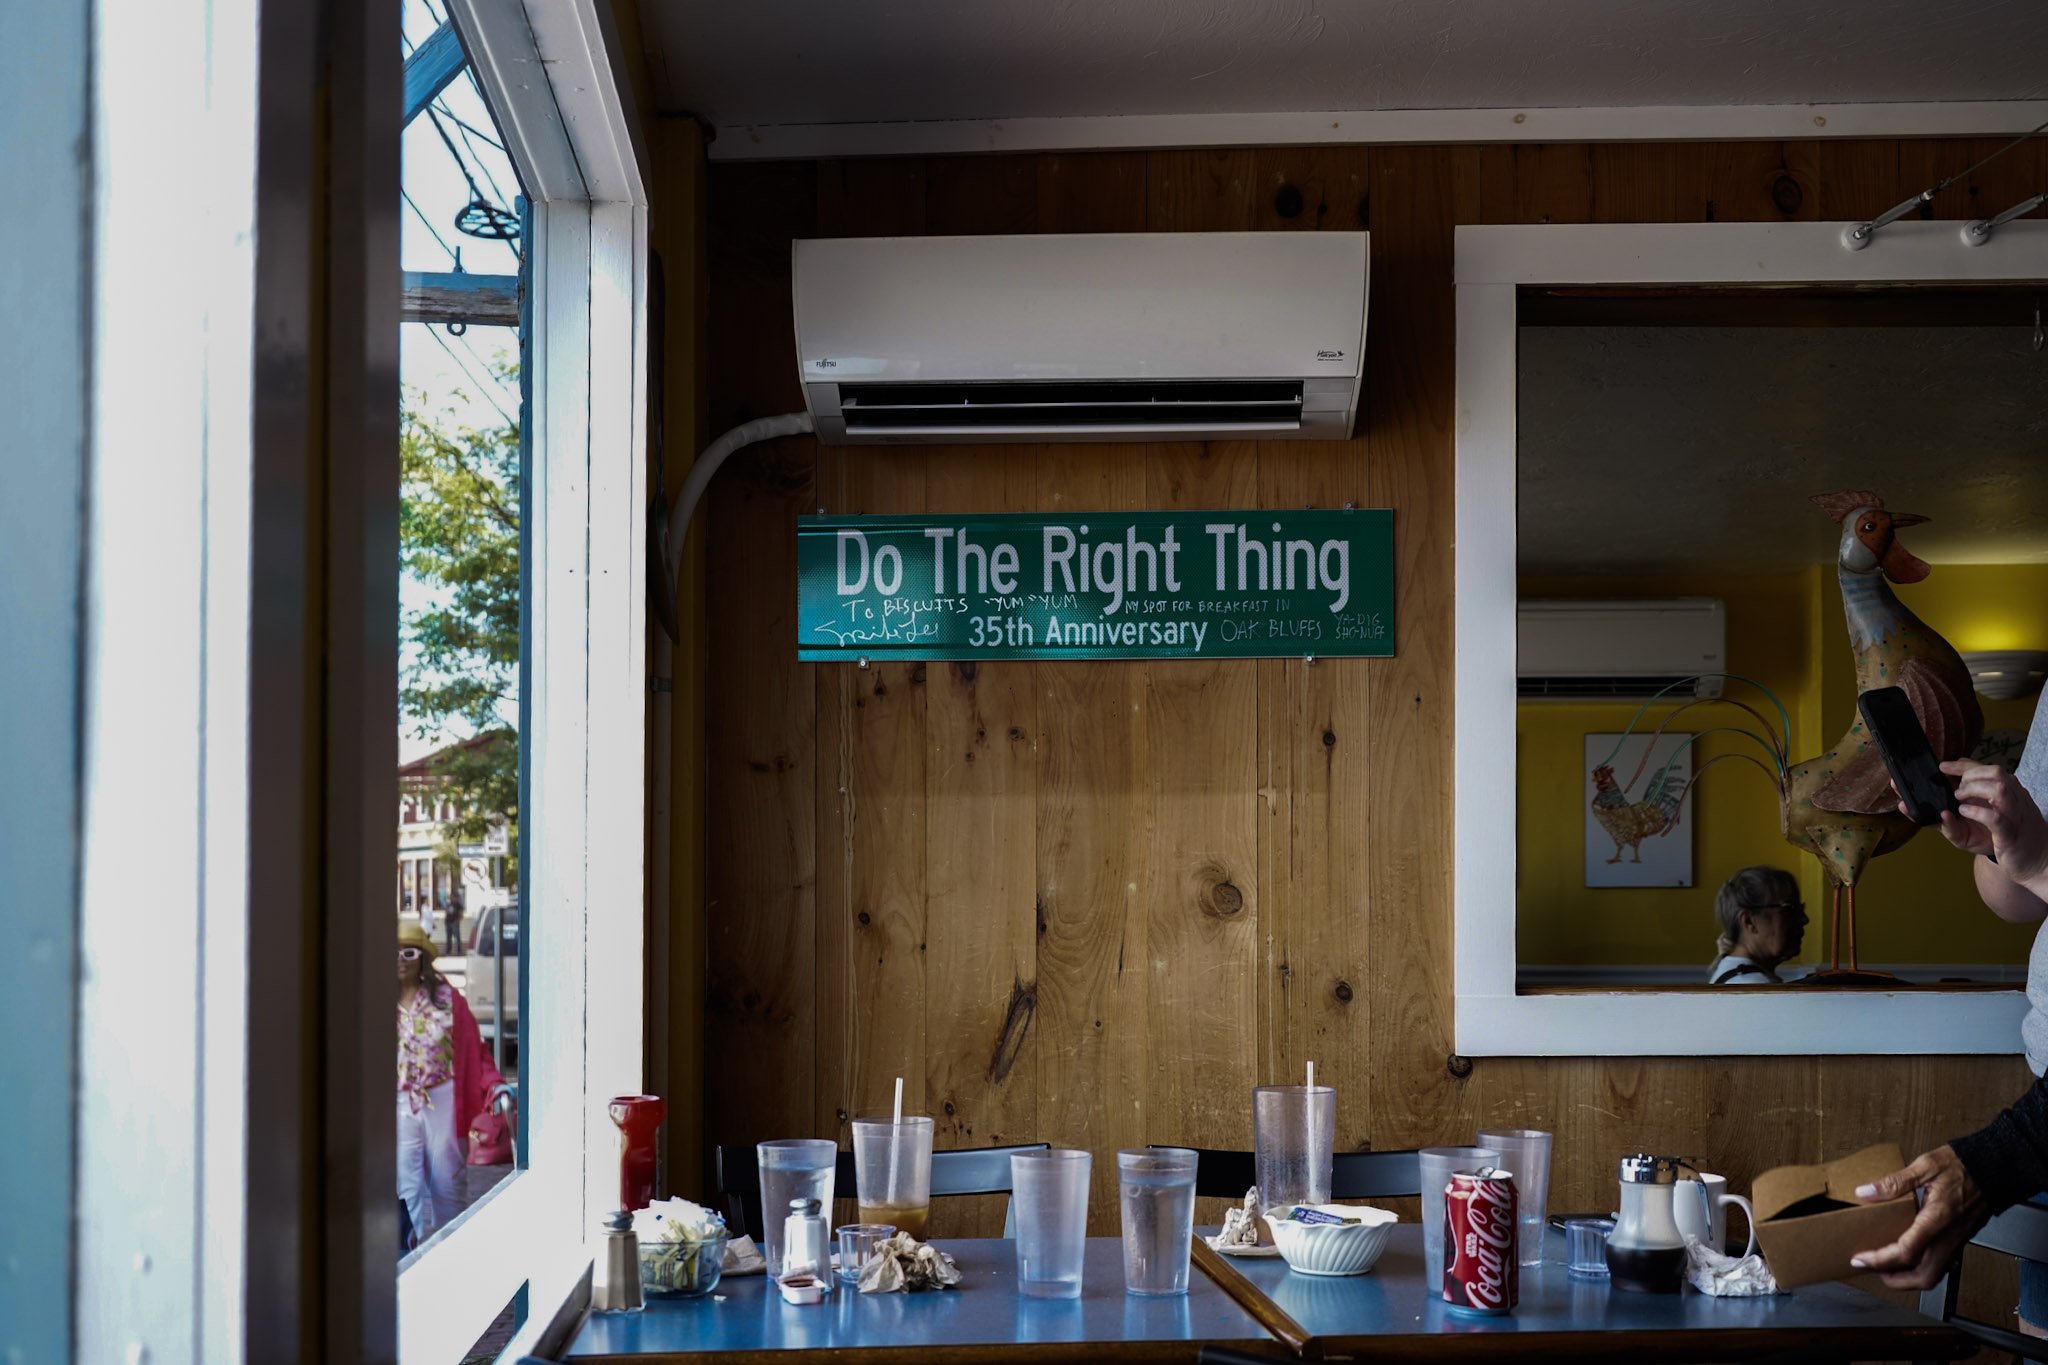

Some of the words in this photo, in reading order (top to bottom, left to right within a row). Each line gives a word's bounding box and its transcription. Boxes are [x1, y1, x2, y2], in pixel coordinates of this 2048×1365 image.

[837, 528, 903, 596] Do
[924, 527, 1020, 595] The
[1043, 525, 1181, 616] Right
[1205, 522, 1350, 614] Thing
[1125, 600, 1139, 614] MY
[1142, 600, 1167, 613] SPOT
[1172, 601, 1193, 612] FOR
[1198, 600, 1268, 613] BREAKFAST
[968, 616, 1034, 647] 35th
[1045, 615, 1208, 652] Anniversary
[1220, 619, 1260, 641] OAK
[1268, 618, 1322, 641] BLUFFS
